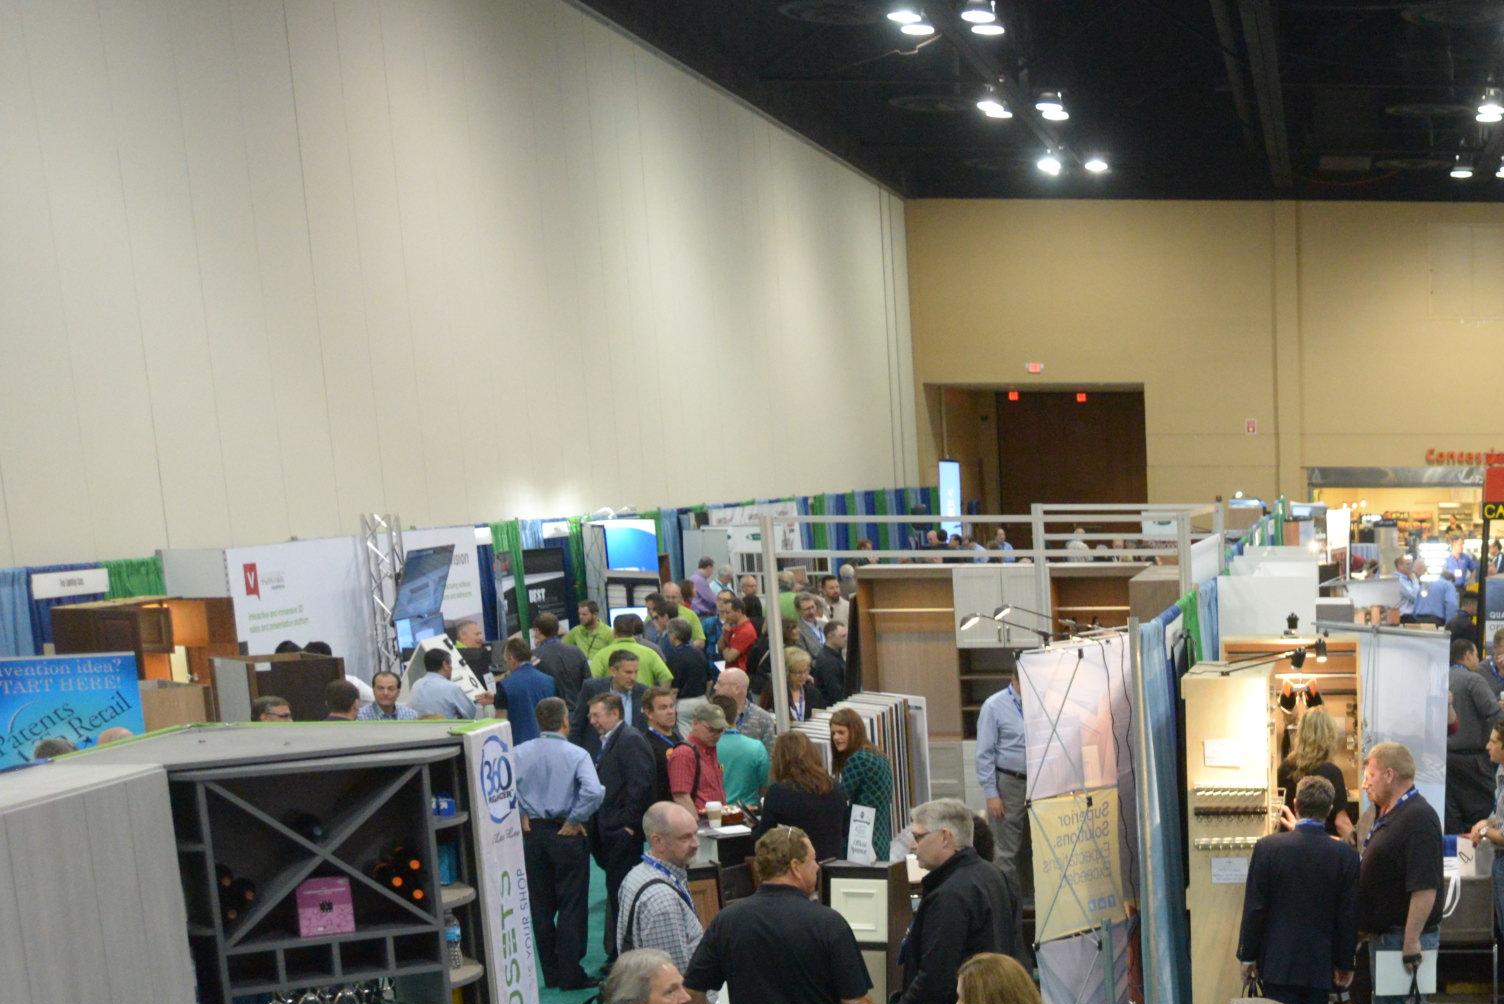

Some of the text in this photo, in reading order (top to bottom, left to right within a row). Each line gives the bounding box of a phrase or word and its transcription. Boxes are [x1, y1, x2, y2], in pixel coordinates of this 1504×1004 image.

[0, 658, 121, 678] vention idea?
[1, 675, 120, 695] TART HERE!
[67, 690, 132, 738] Retail
[483, 755, 512, 797] 360
[516, 868, 529, 912] SHOP
